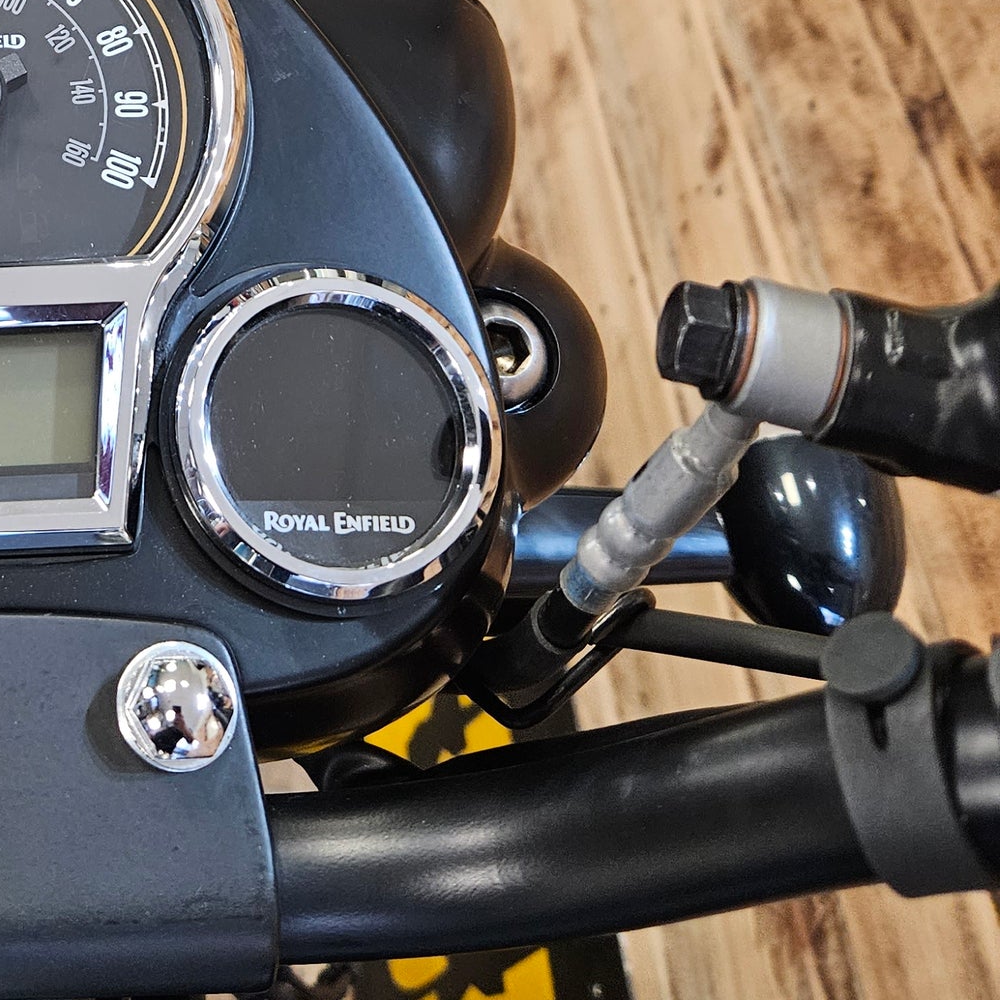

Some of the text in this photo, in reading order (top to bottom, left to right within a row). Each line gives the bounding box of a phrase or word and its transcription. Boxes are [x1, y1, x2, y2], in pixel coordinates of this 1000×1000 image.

[44, 23, 76, 54] 120
[96, 25, 134, 57] 80
[69, 77, 96, 105] 140
[114, 91, 149, 118] 90
[61, 137, 92, 168] 160
[100, 149, 143, 190] 100
[263, 510, 416, 535] ROYAL ENFIELD
